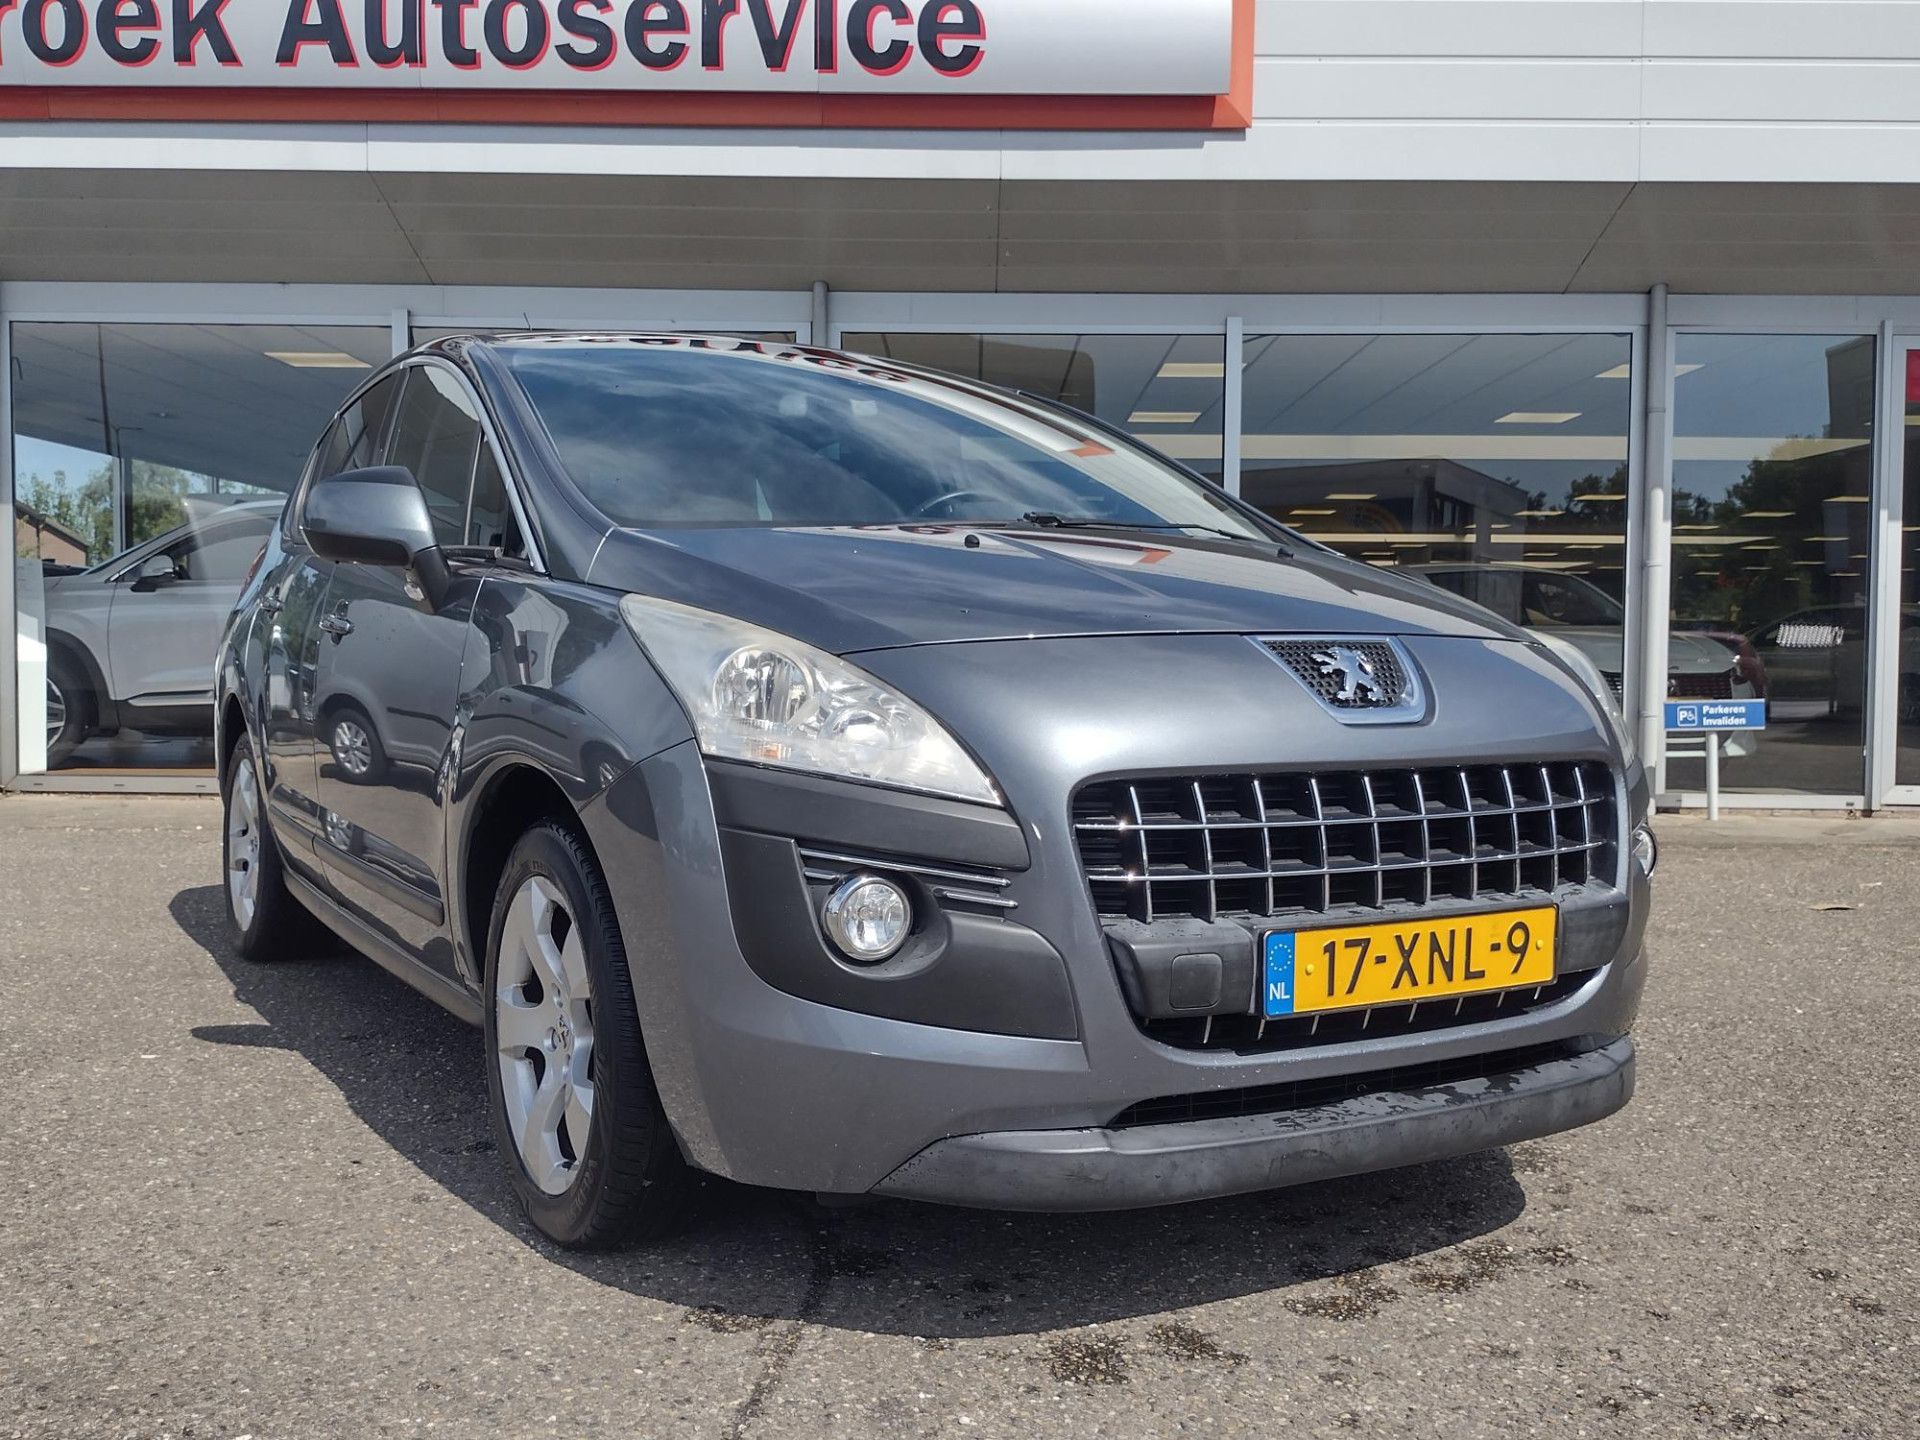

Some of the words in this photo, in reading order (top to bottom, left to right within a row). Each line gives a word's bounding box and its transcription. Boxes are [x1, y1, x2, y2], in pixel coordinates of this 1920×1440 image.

[275, 0, 986, 77] Autoservice
[1702, 705, 1745, 715] Parkeren
[1702, 716, 1746, 726] Invaliden
[1322, 921, 1531, 997] 17-XNL-9
[1269, 981, 1290, 1001] NL
